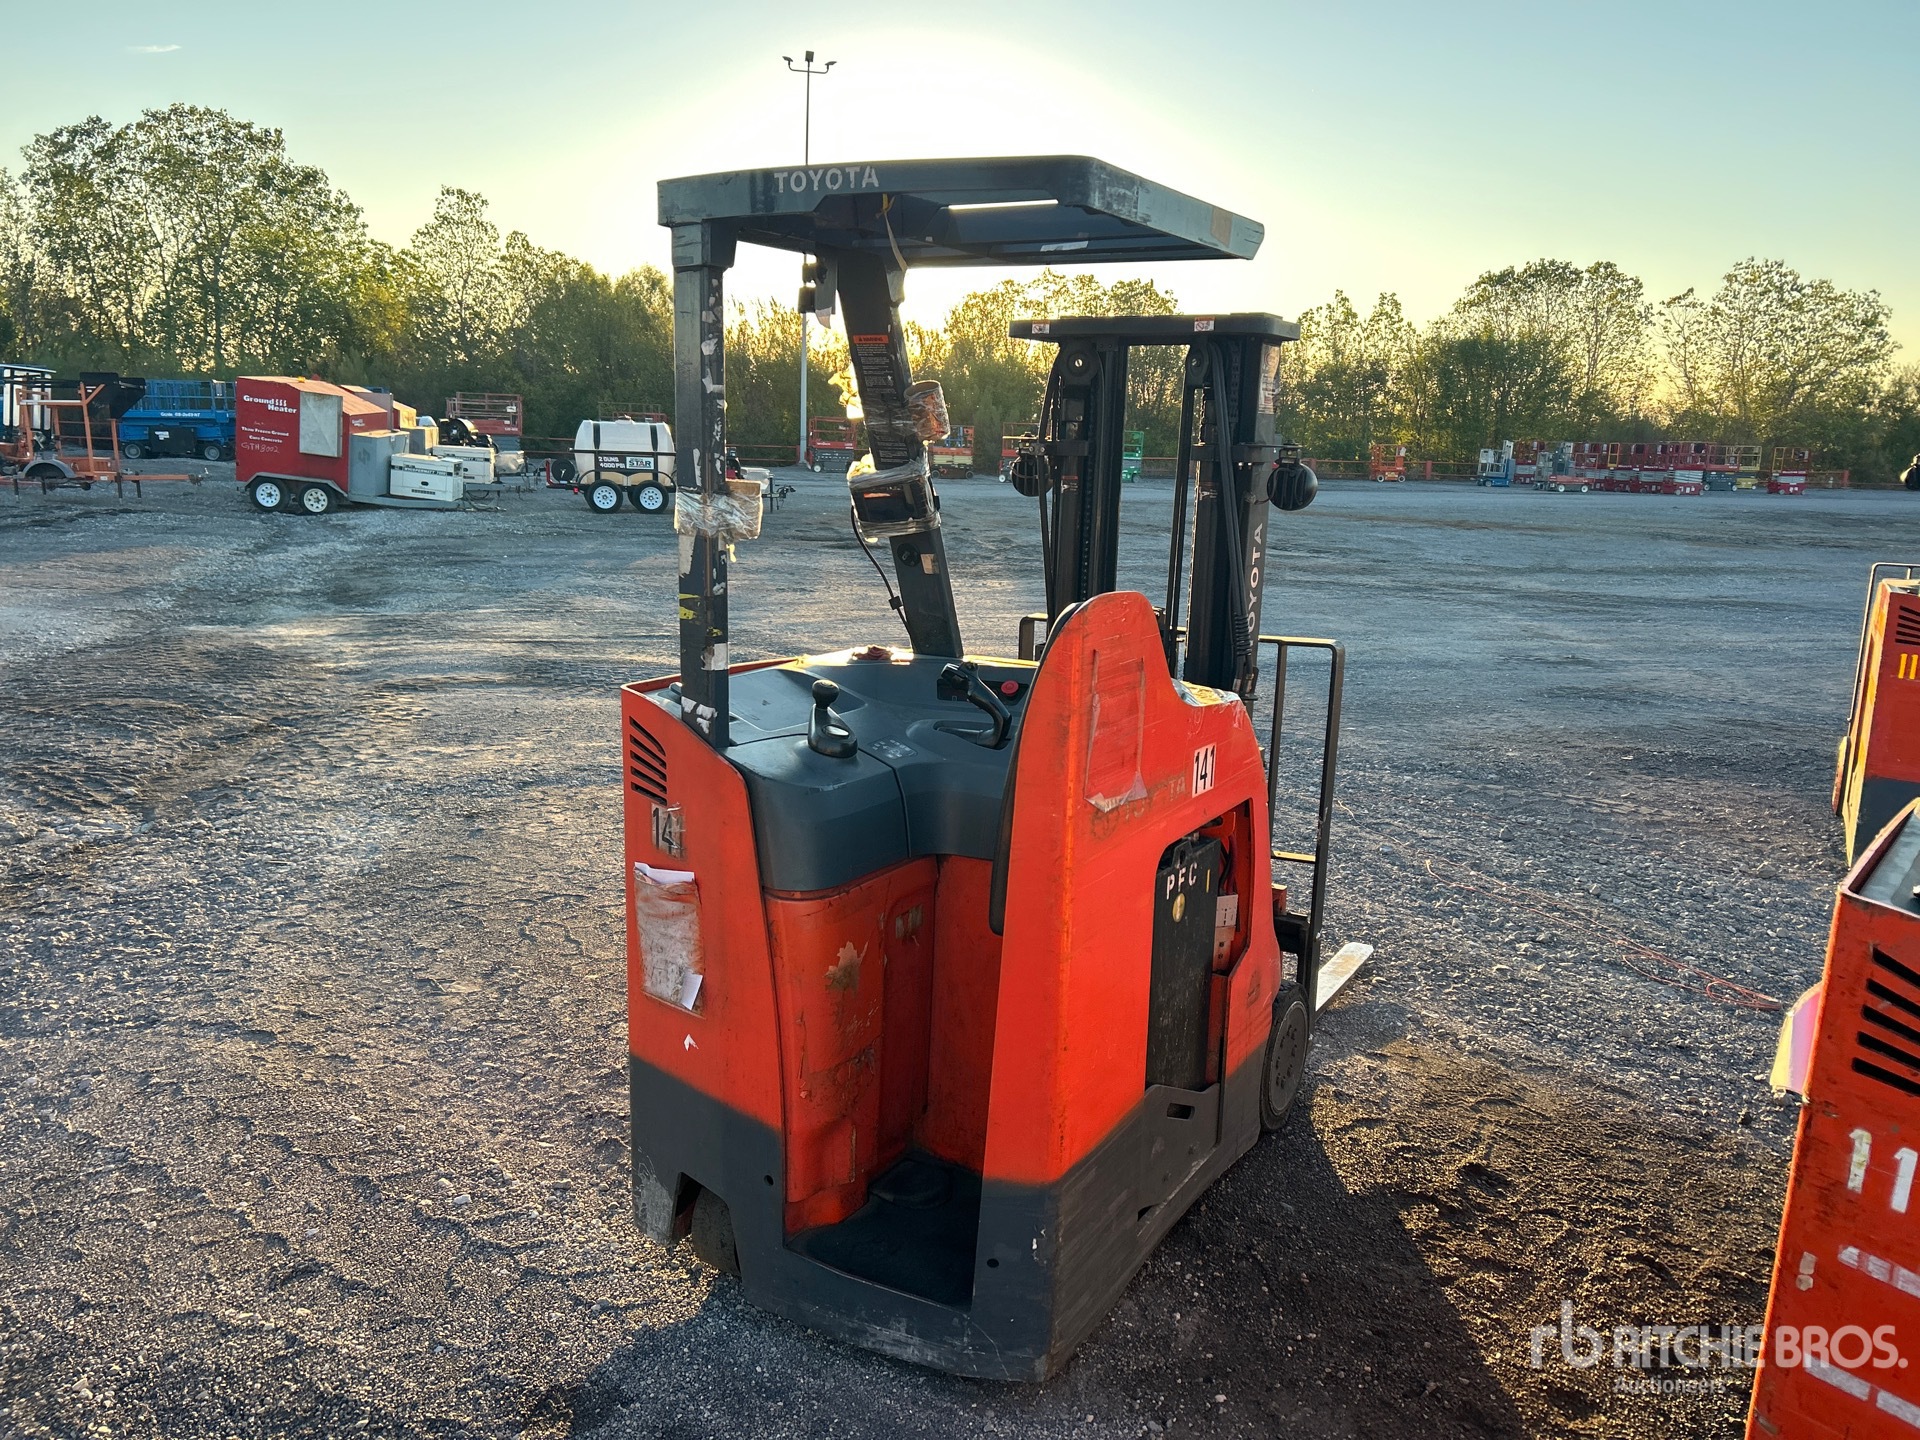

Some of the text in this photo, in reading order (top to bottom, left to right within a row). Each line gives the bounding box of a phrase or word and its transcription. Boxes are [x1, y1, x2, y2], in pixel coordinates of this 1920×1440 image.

[774, 165, 880, 193] TOYOTA
[243, 395, 274, 405] Ground
[267, 404, 297, 414] Heater
[628, 460, 652, 468] STAR
[1195, 745, 1216, 795] 141
[1166, 862, 1198, 900] PFC
[1847, 1128, 1919, 1214] 11
